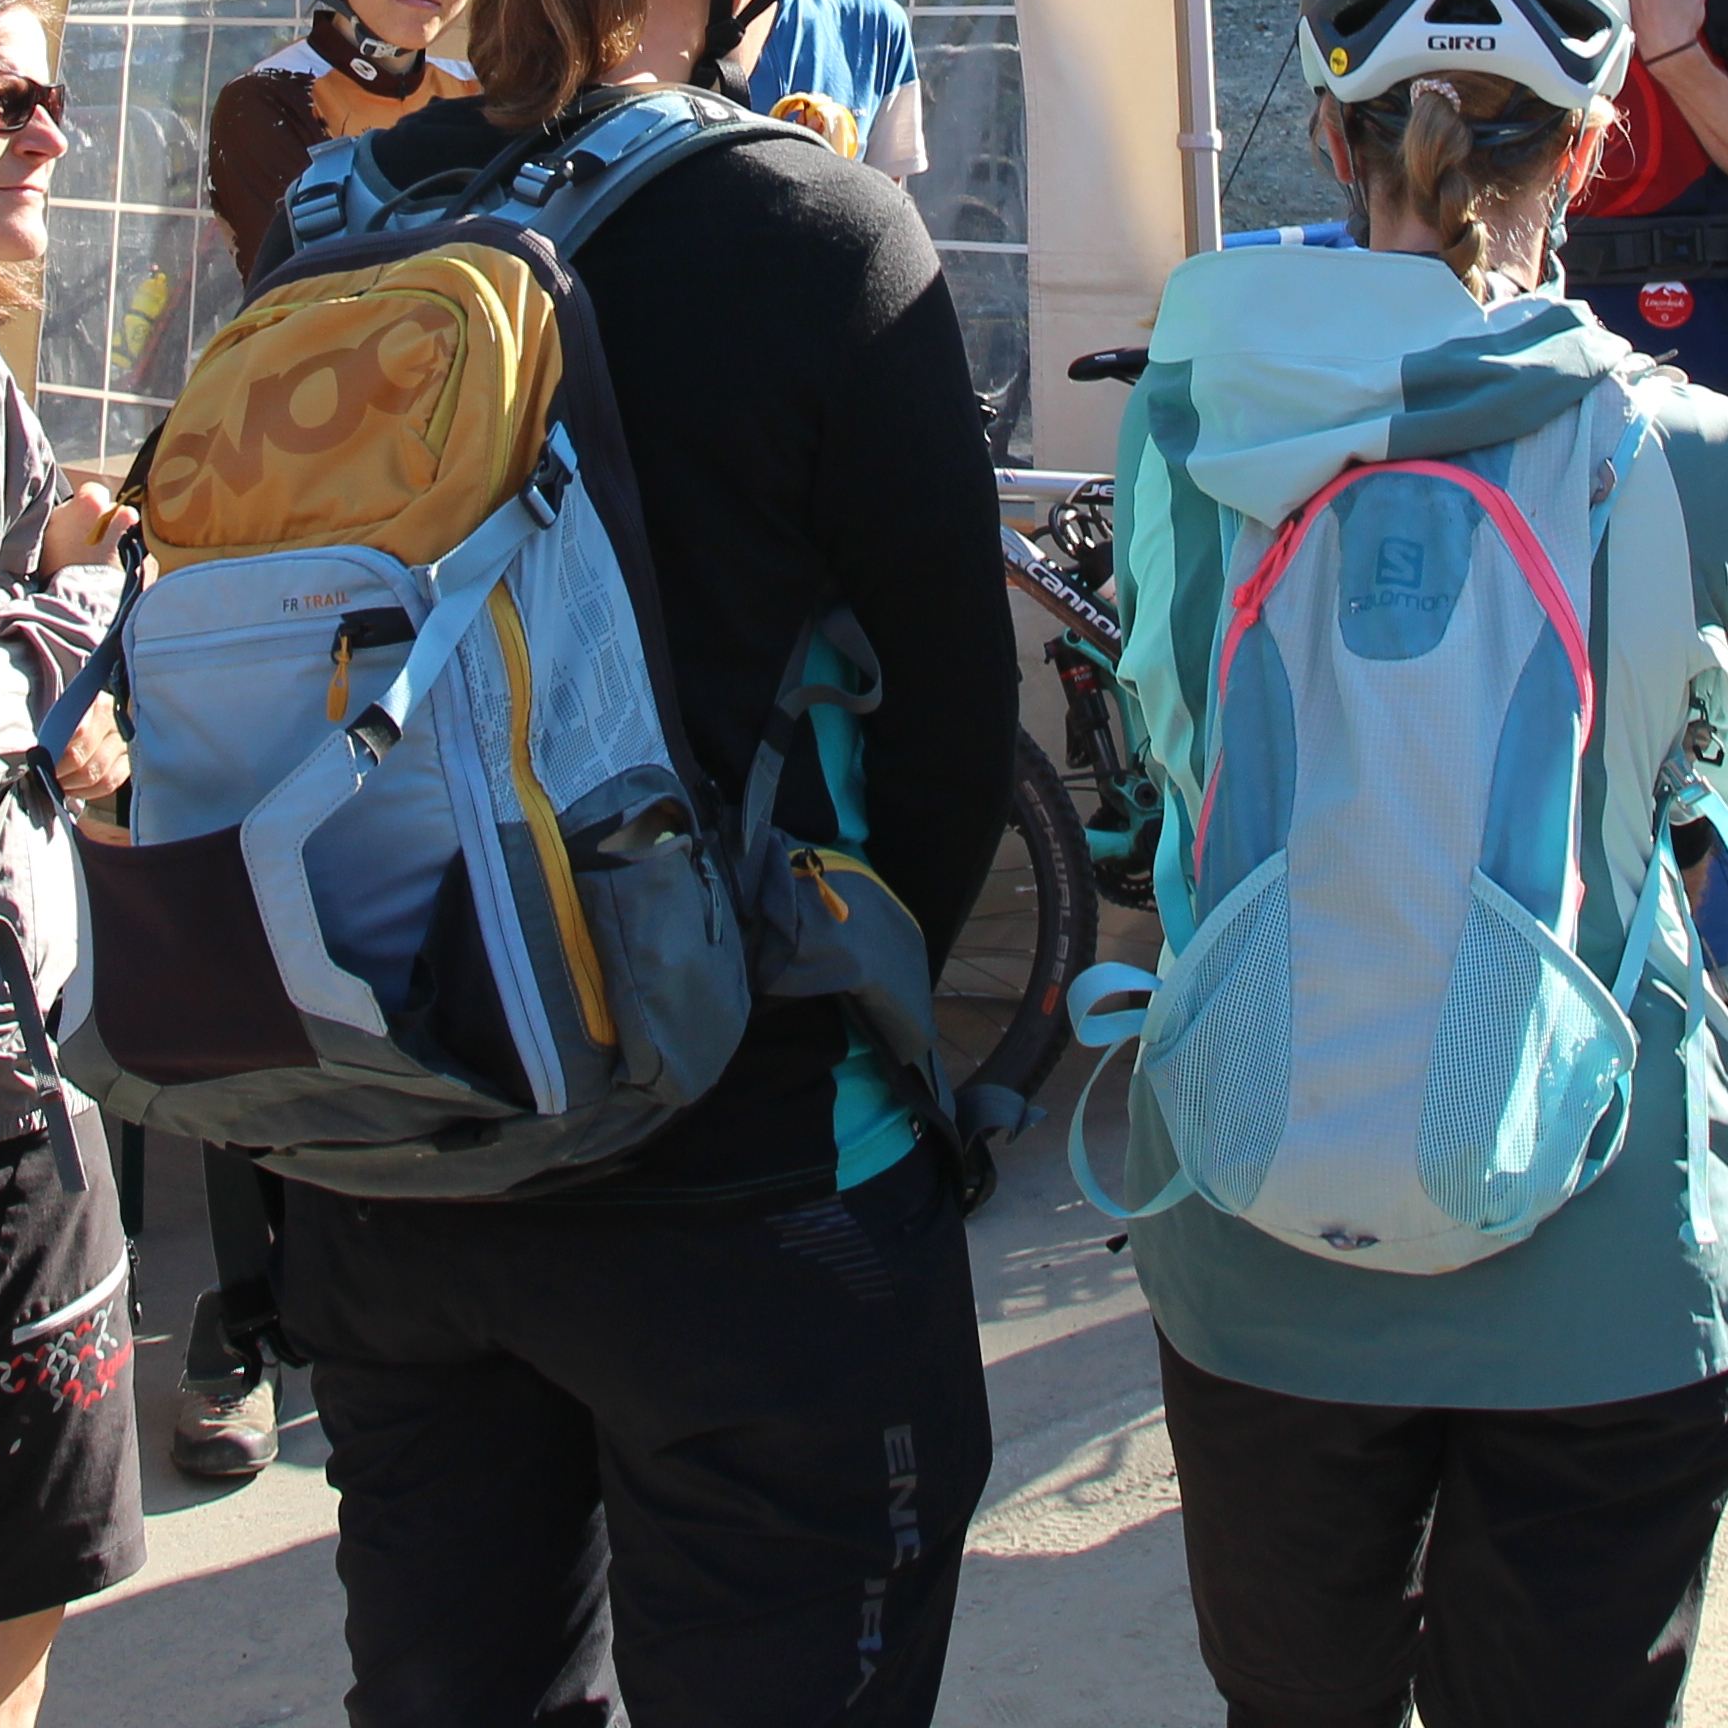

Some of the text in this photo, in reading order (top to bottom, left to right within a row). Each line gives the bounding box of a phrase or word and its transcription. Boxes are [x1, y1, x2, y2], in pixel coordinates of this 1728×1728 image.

[1427, 35, 1497, 51] GIRO
[282, 591, 351, 613] FR TRAIL
[1022, 779, 1071, 985] SCHWALBE
